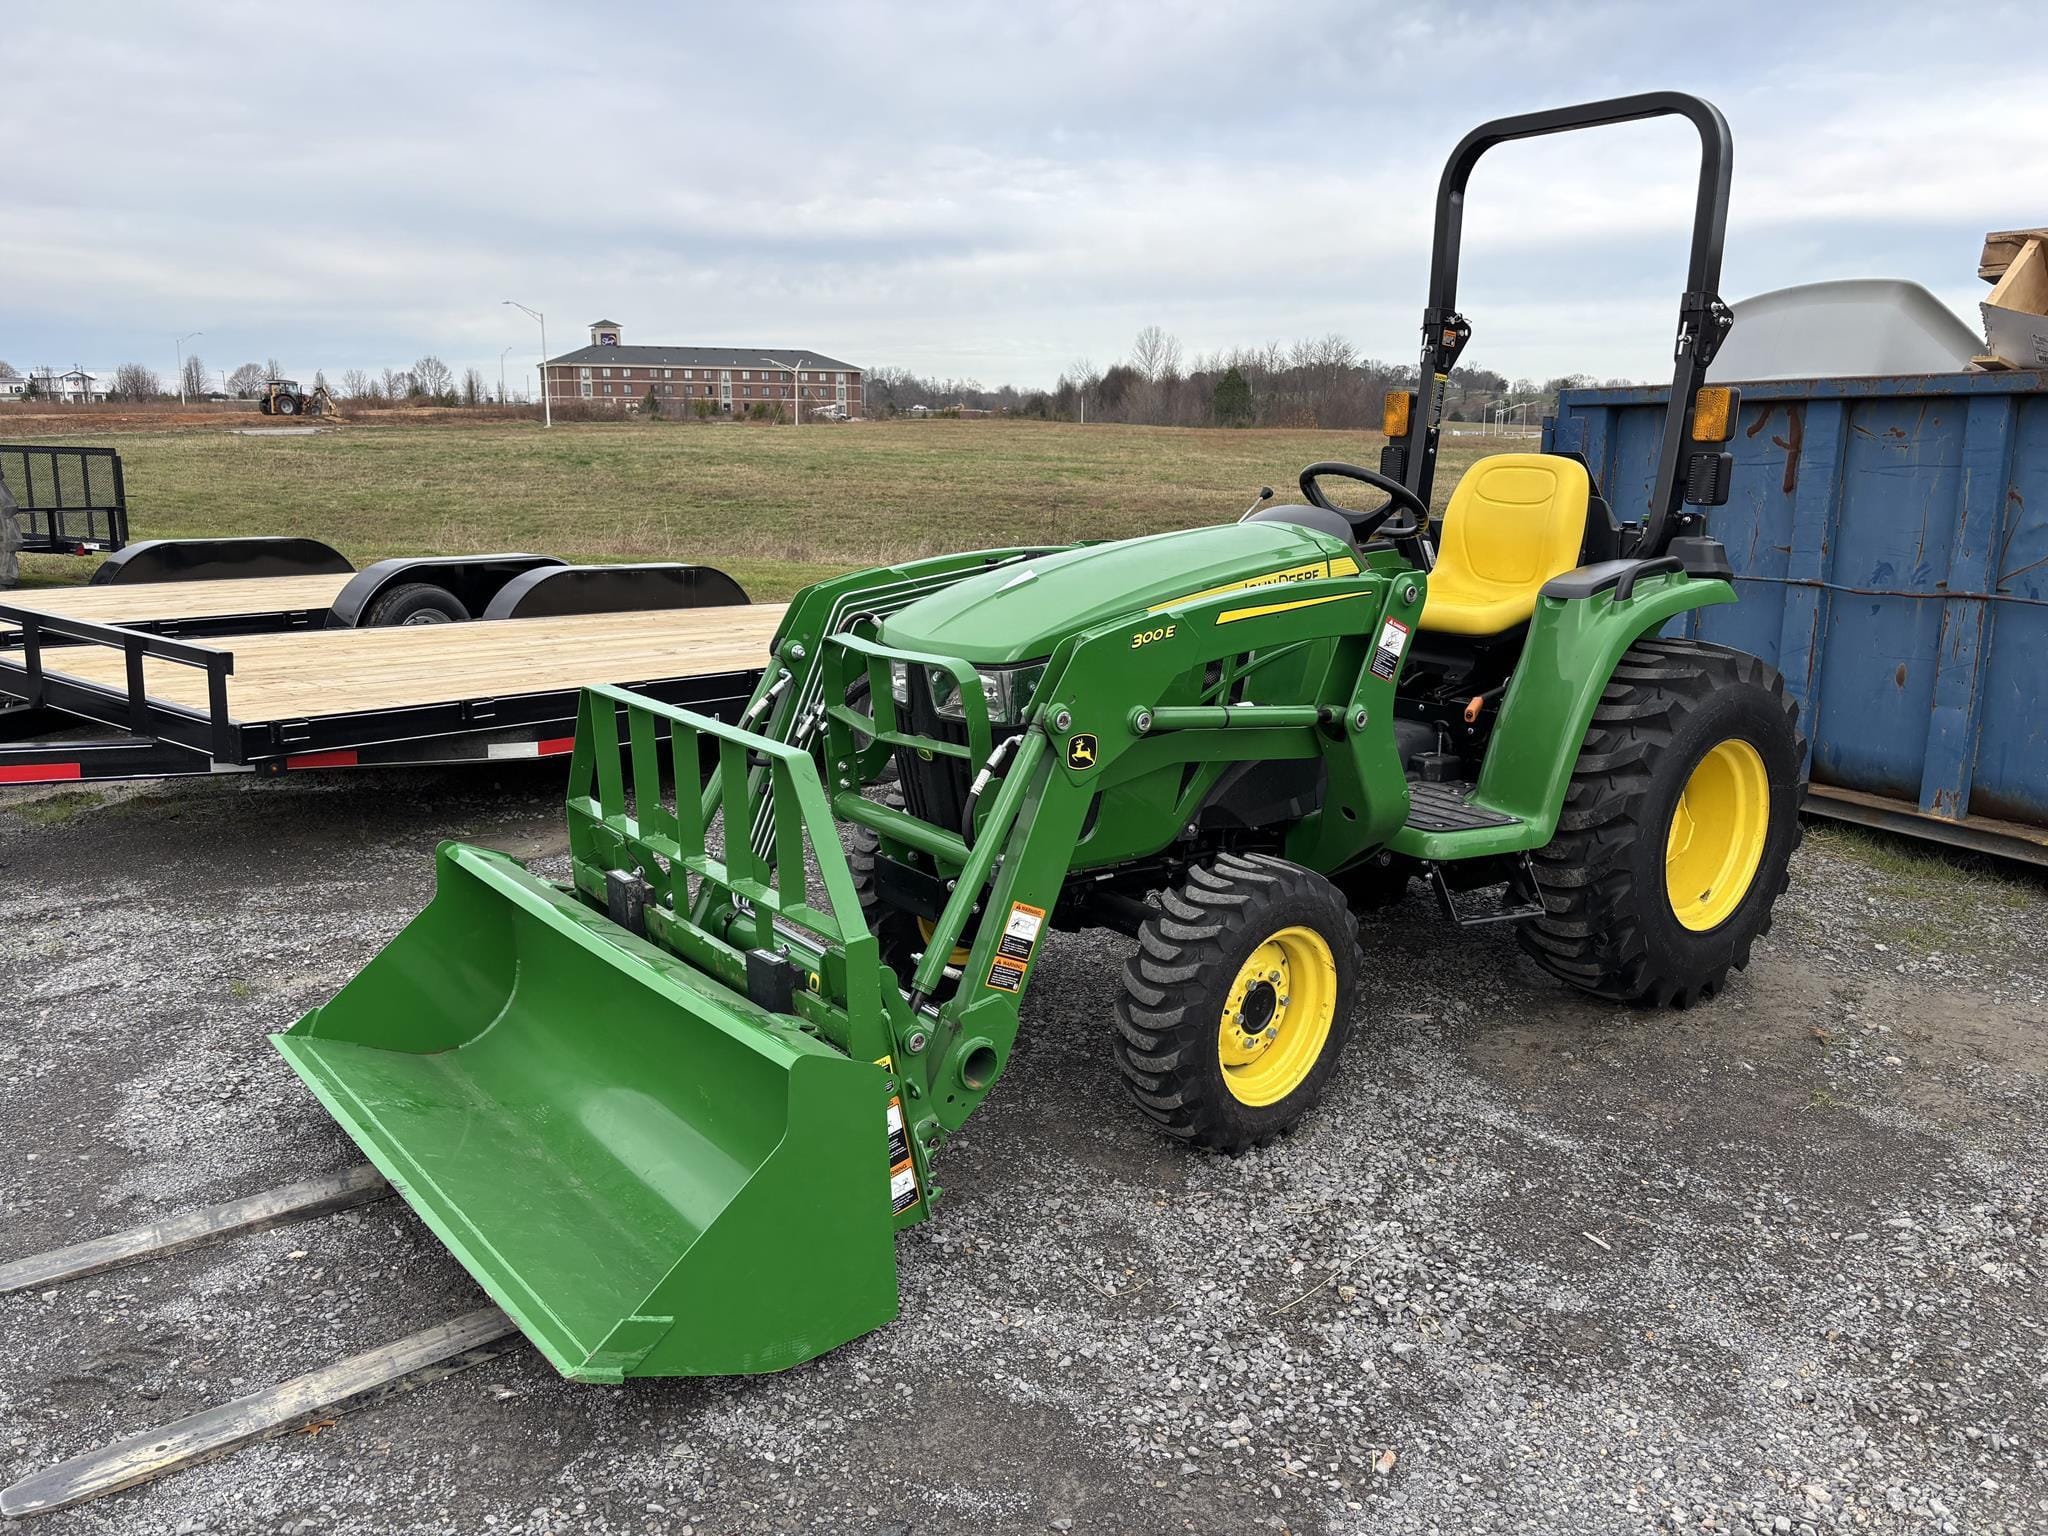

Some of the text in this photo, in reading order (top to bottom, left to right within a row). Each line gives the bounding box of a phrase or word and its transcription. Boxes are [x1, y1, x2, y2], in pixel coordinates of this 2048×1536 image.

[1021, 906, 1042, 915] WARNING
[1003, 961, 1023, 970] WARNING
[890, 1163, 907, 1177] RNING
